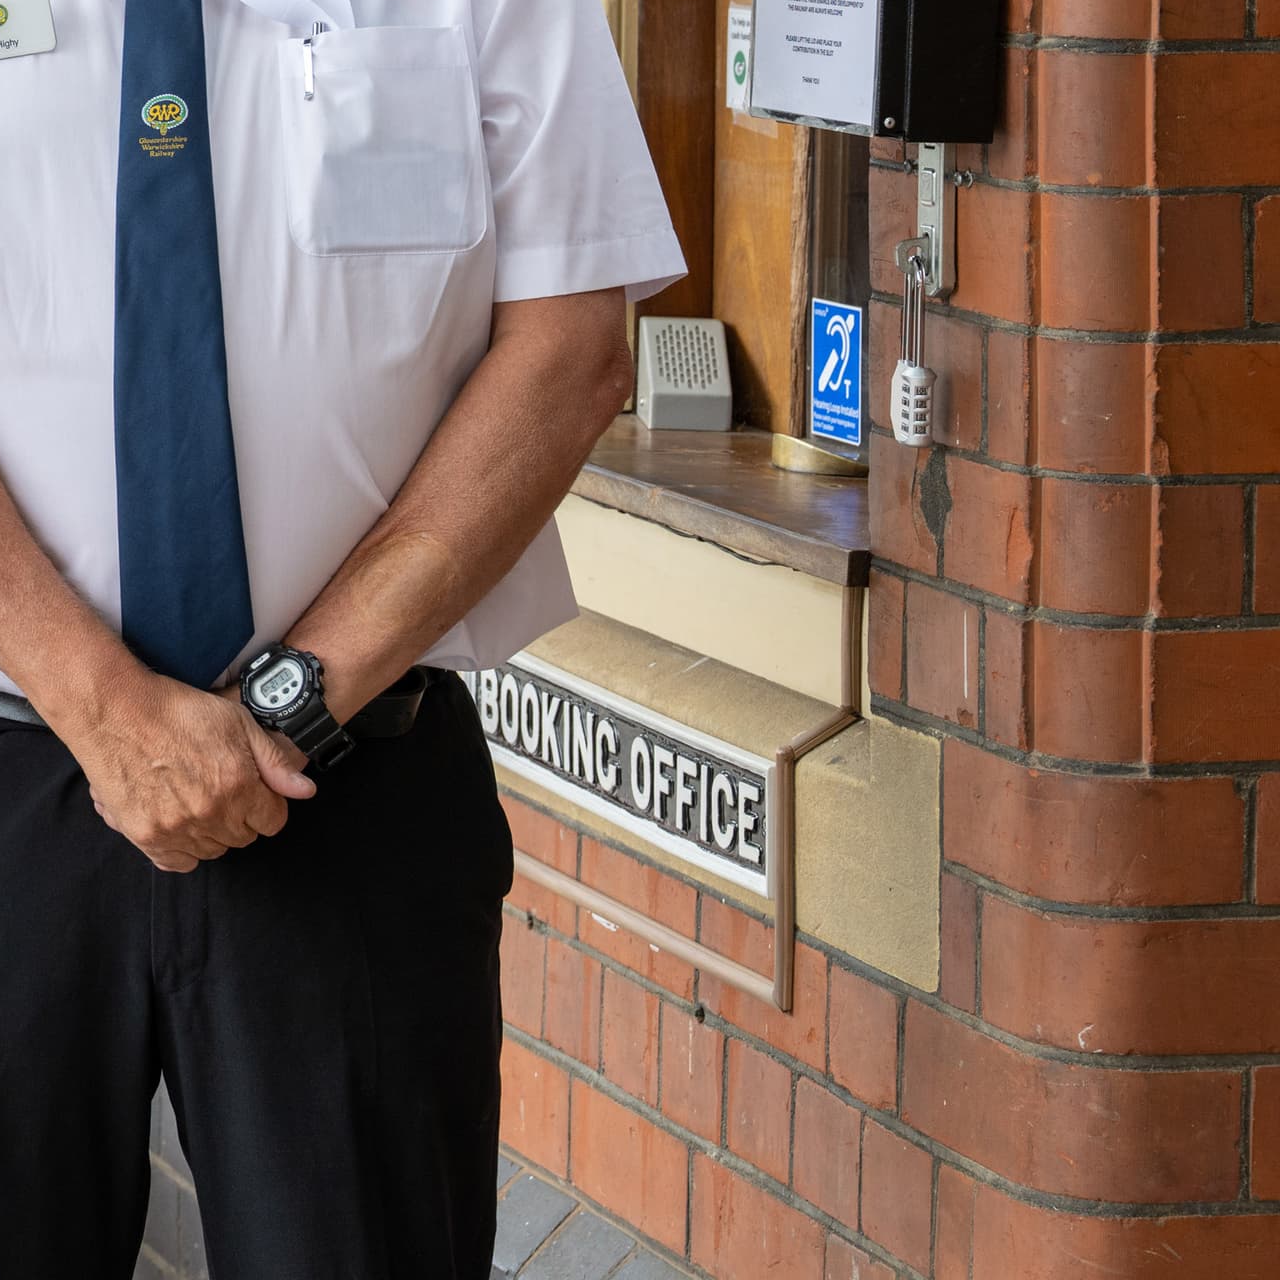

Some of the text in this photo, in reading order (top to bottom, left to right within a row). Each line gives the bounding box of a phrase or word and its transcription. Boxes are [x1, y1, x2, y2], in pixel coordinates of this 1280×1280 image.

[149, 150, 175, 158] Railway
[480, 668, 764, 865] BOOKING OFFICE
